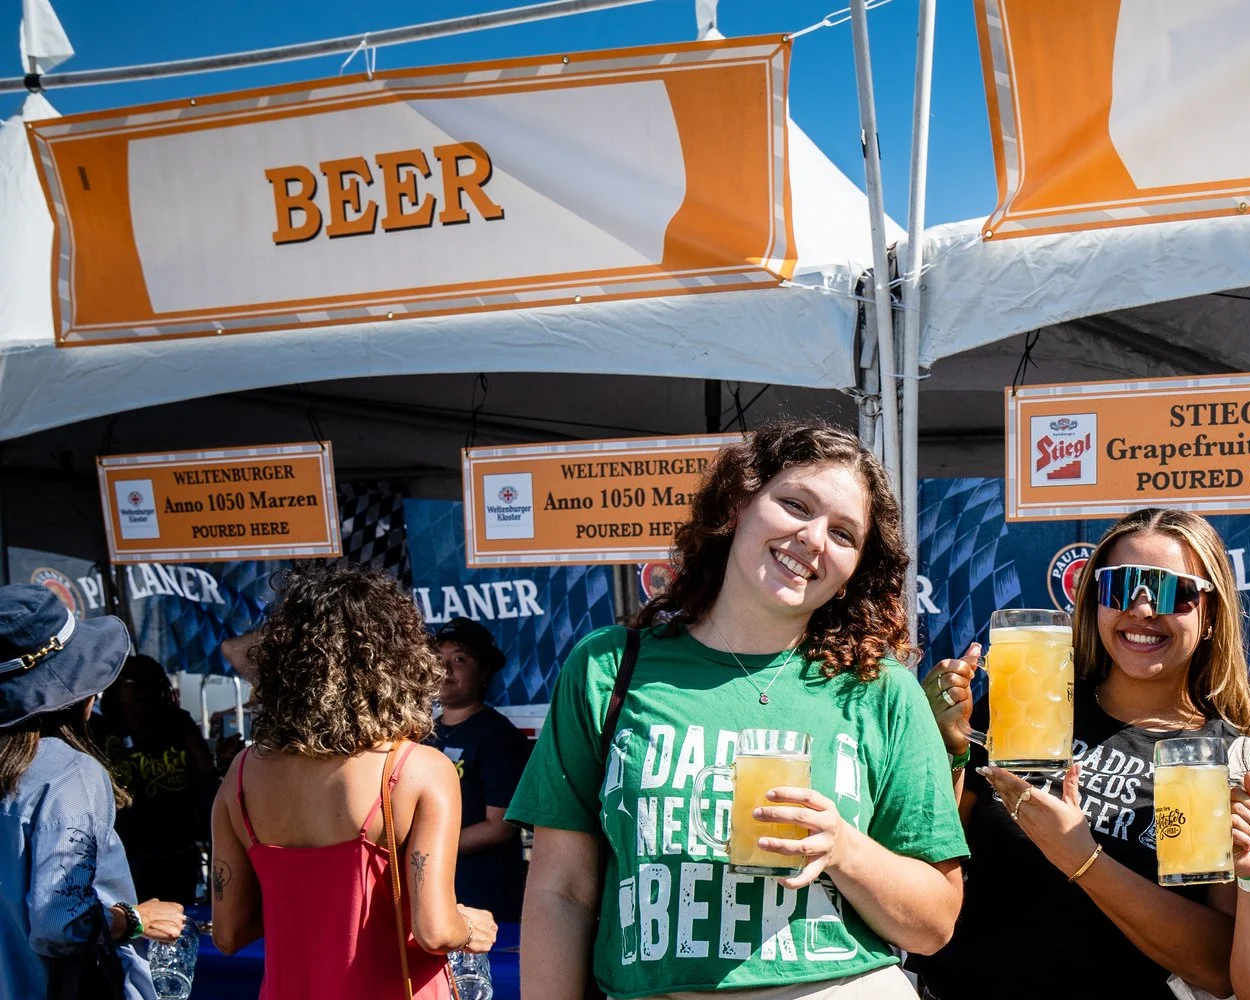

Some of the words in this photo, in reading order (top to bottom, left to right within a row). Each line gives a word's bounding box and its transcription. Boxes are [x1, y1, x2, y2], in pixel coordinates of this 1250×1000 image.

[265, 141, 504, 245] BEER
[1036, 432, 1092, 472] Stiegl
[173, 464, 295, 486] WELTENBURGER
[1136, 468, 1244, 491] POURED
[164, 496, 203, 514] Anno
[208, 492, 246, 512] 1050
[250, 491, 318, 510] Marzen
[487, 504, 531, 515] Weltenburger
[543, 491, 593, 511] Anno
[600, 487, 645, 509] 1050
[651, 486, 696, 507] Mar
[192, 524, 246, 539] POURED
[250, 521, 290, 537] HERE
[496, 513, 521, 521] Kloster
[576, 522, 644, 539] POURED
[649, 520, 682, 537] HER
[1052, 547, 1095, 579] PAULA
[77, 562, 226, 609] PLANER
[414, 579, 544, 624] LANER
[641, 724, 745, 792] DAD
[1051, 768, 1142, 805] EEDS
[636, 797, 732, 857] NEED
[1078, 794, 1136, 841] EER
[638, 862, 799, 962] BEER
